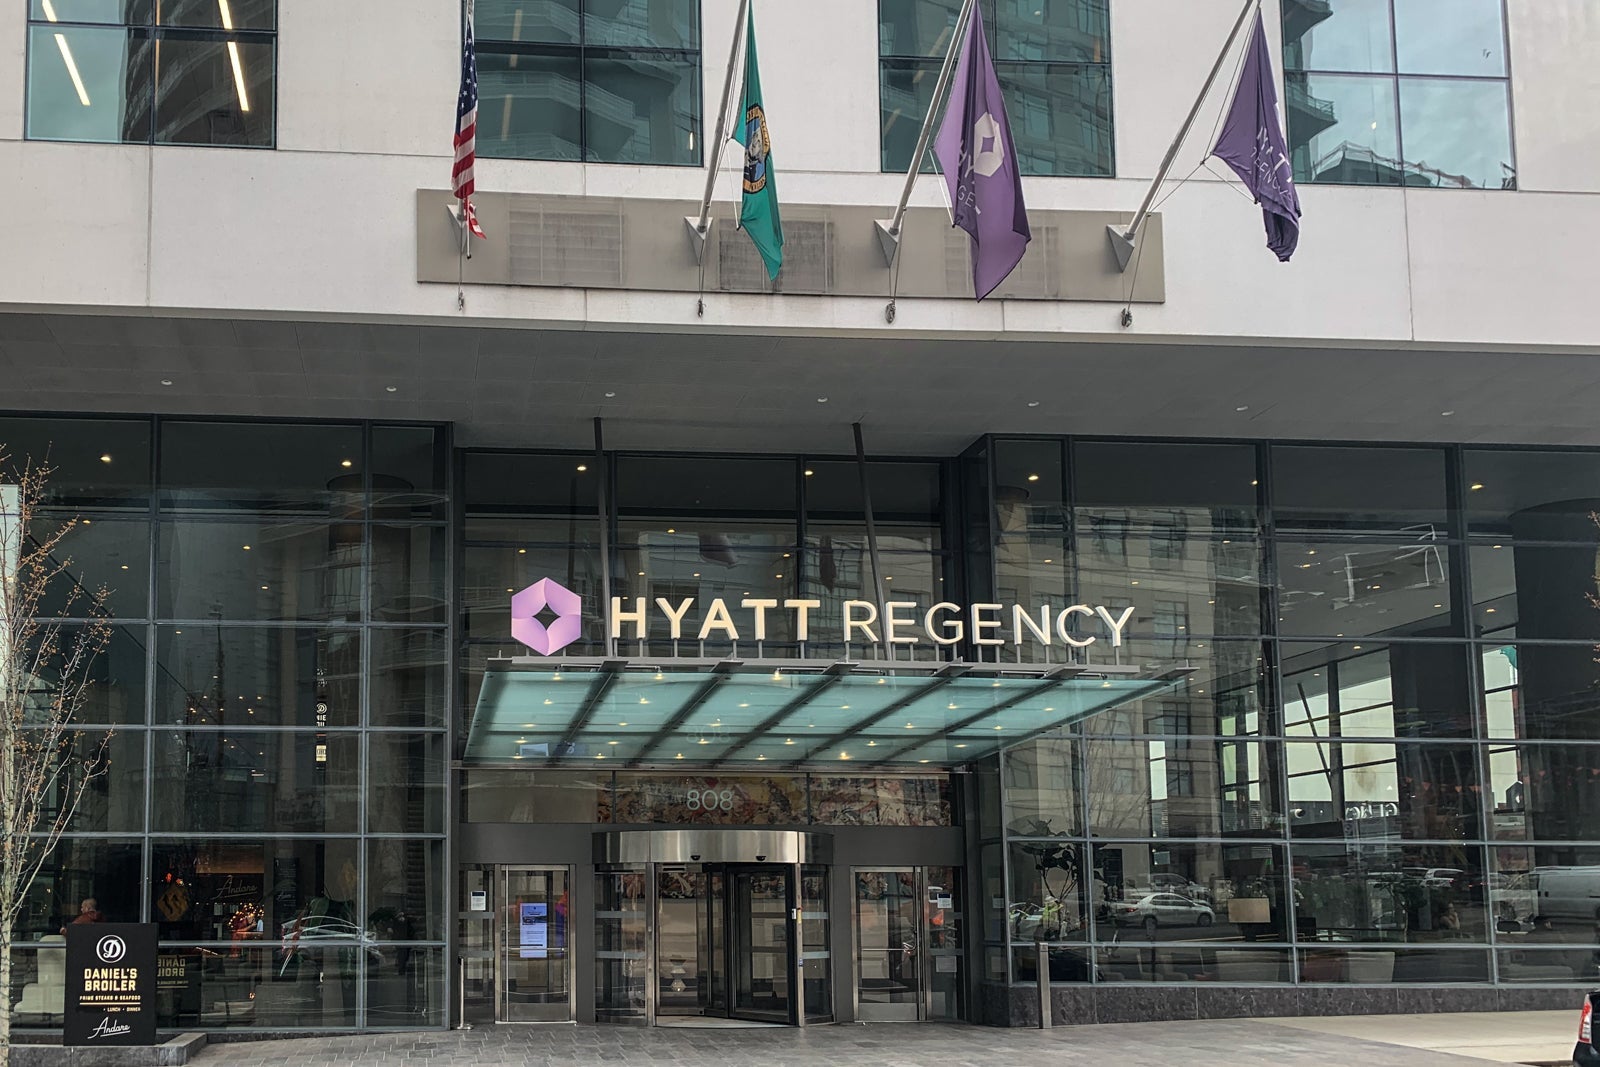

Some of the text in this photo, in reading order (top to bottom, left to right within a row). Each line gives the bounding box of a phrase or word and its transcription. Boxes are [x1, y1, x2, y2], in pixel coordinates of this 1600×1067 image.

[611, 597, 1135, 647] HYATT REGENCY
[687, 790, 733, 810] 808
[211, 875, 258, 900] Andare
[84, 968, 138, 980] DANIEL'S
[84, 979, 136, 992] BROILER
[87, 1016, 131, 1039] Andare
